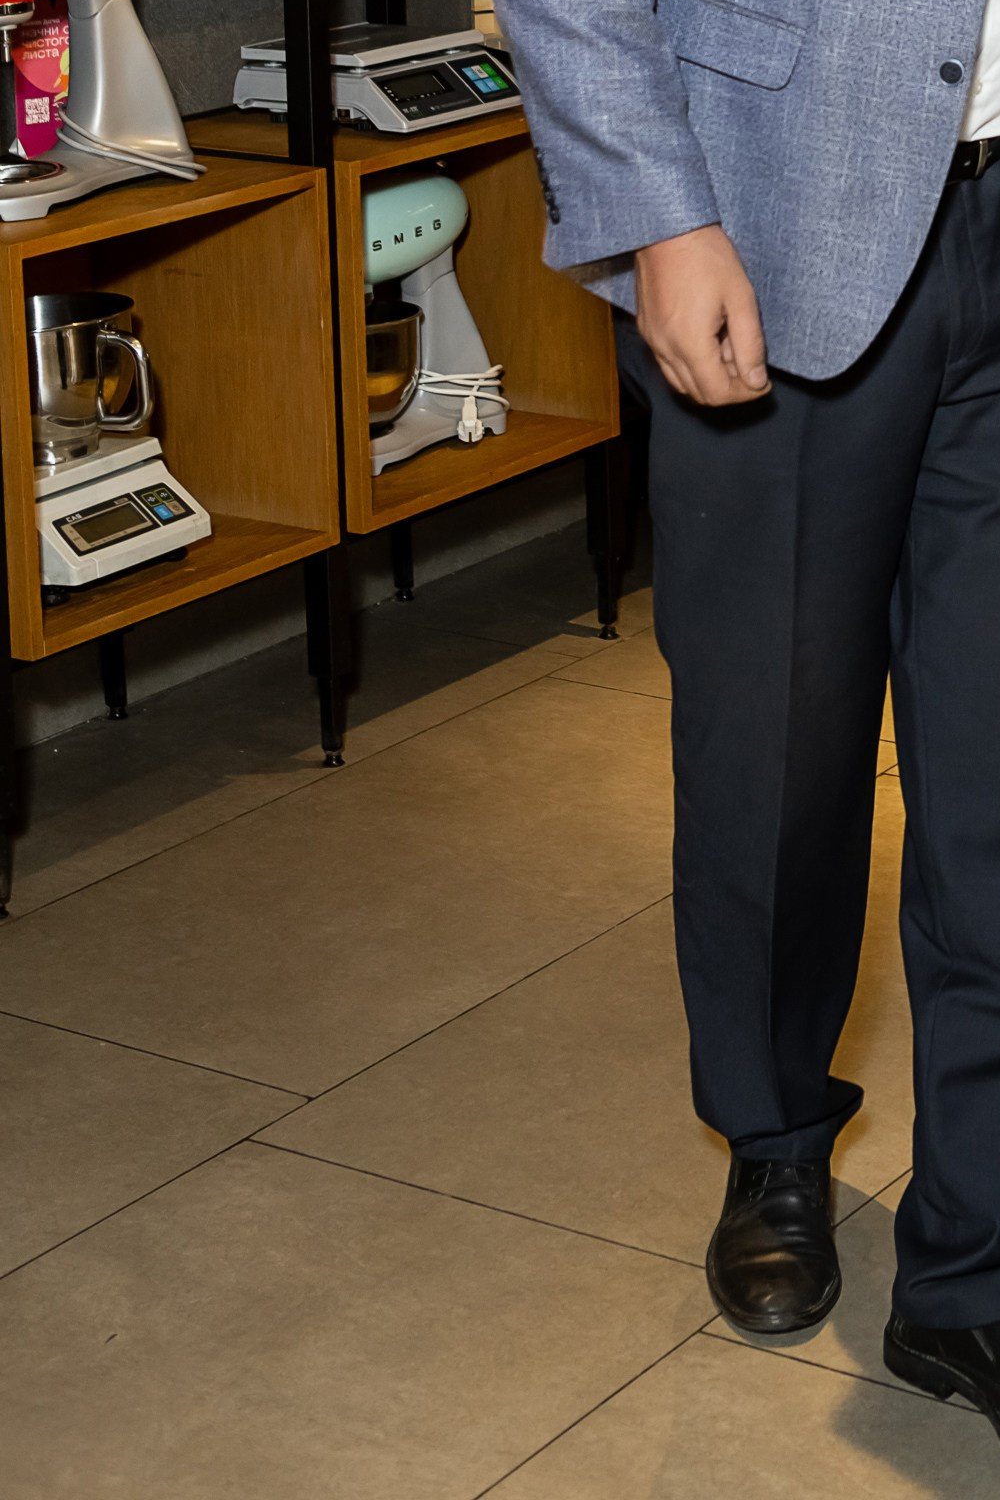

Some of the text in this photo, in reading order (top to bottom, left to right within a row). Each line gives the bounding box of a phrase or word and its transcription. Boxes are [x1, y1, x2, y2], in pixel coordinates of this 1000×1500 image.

[22, 48, 60, 61] листа
[372, 219, 441, 252] SMEG
[66, 513, 83, 523] CAS
